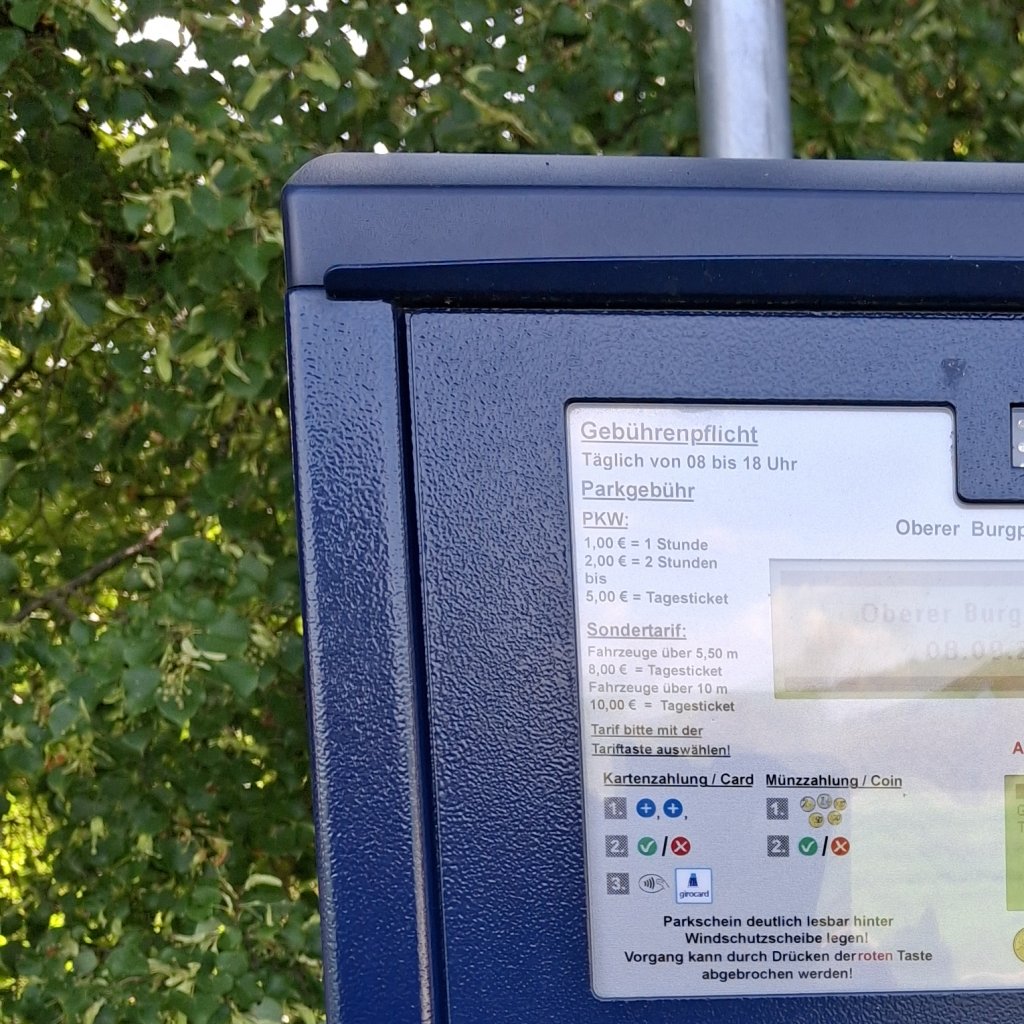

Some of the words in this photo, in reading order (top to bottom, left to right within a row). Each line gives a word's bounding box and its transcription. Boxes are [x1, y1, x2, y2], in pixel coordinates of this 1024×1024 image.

[580, 421, 759, 446] Gebührenpflicht
[582, 452, 644, 470] Täglich
[650, 457, 681, 468] von
[687, 455, 706, 469] 08
[712, 455, 737, 470] bis
[743, 456, 761, 470] 18
[767, 456, 798, 471] Uhr
[581, 480, 695, 502] Parkgebühr
[582, 511, 629, 529] PKW:
[896, 519, 960, 537] Oberer
[584, 537, 613, 550] 1,00
[657, 538, 709, 551] Stunde
[584, 555, 614, 568] 2,00
[645, 556, 653, 568] 2
[658, 556, 718, 569] Stunden
[585, 572, 607, 585] bis
[586, 590, 615, 603] 5,00
[646, 591, 729, 606] Tagesticket
[860, 603, 951, 624] Oberer
[587, 622, 687, 640] Sondertarif:
[588, 646, 658, 660] Fahrzeuge
[662, 647, 692, 659] über
[696, 648, 723, 661] 5,50
[727, 649, 738, 659] m
[588, 664, 616, 677] 8,00
[648, 664, 723, 678] Tagesticket
[588, 682, 659, 695] Fahrzeuge
[663, 683, 693, 694] über
[699, 684, 712, 694] 10
[716, 685, 728, 694] m
[590, 699, 624, 712] 10,00
[661, 700, 735, 714] Tagesticket
[591, 723, 620, 737] Tarif
[624, 724, 653, 737] bitte
[658, 724, 678, 737] mit
[682, 725, 703, 738] der
[592, 744, 652, 757] Tariftaste
[656, 745, 731, 758] auswählen!
[603, 772, 708, 787] Kartenzahlung
[720, 773, 754, 787] Card
[766, 774, 858, 789] Münzzahlung
[871, 775, 903, 789] Coin
[679, 890, 710, 899] girocard
[663, 915, 742, 928] Parkschein
[746, 915, 802, 928] deutlich
[807, 915, 850, 928] lesbar
[853, 915, 894, 927] hinter
[685, 932, 823, 944] Windschutzscheibe
[826, 932, 870, 946] legen!
[624, 951, 684, 965] Vorgang
[688, 951, 722, 963] kann
[727, 950, 768, 963] durch
[772, 950, 830, 963] Drücken
[858, 950, 893, 962] roten
[897, 950, 933, 962] Taste
[701, 968, 793, 982] abgebrochen
[798, 968, 853, 980] werden!
